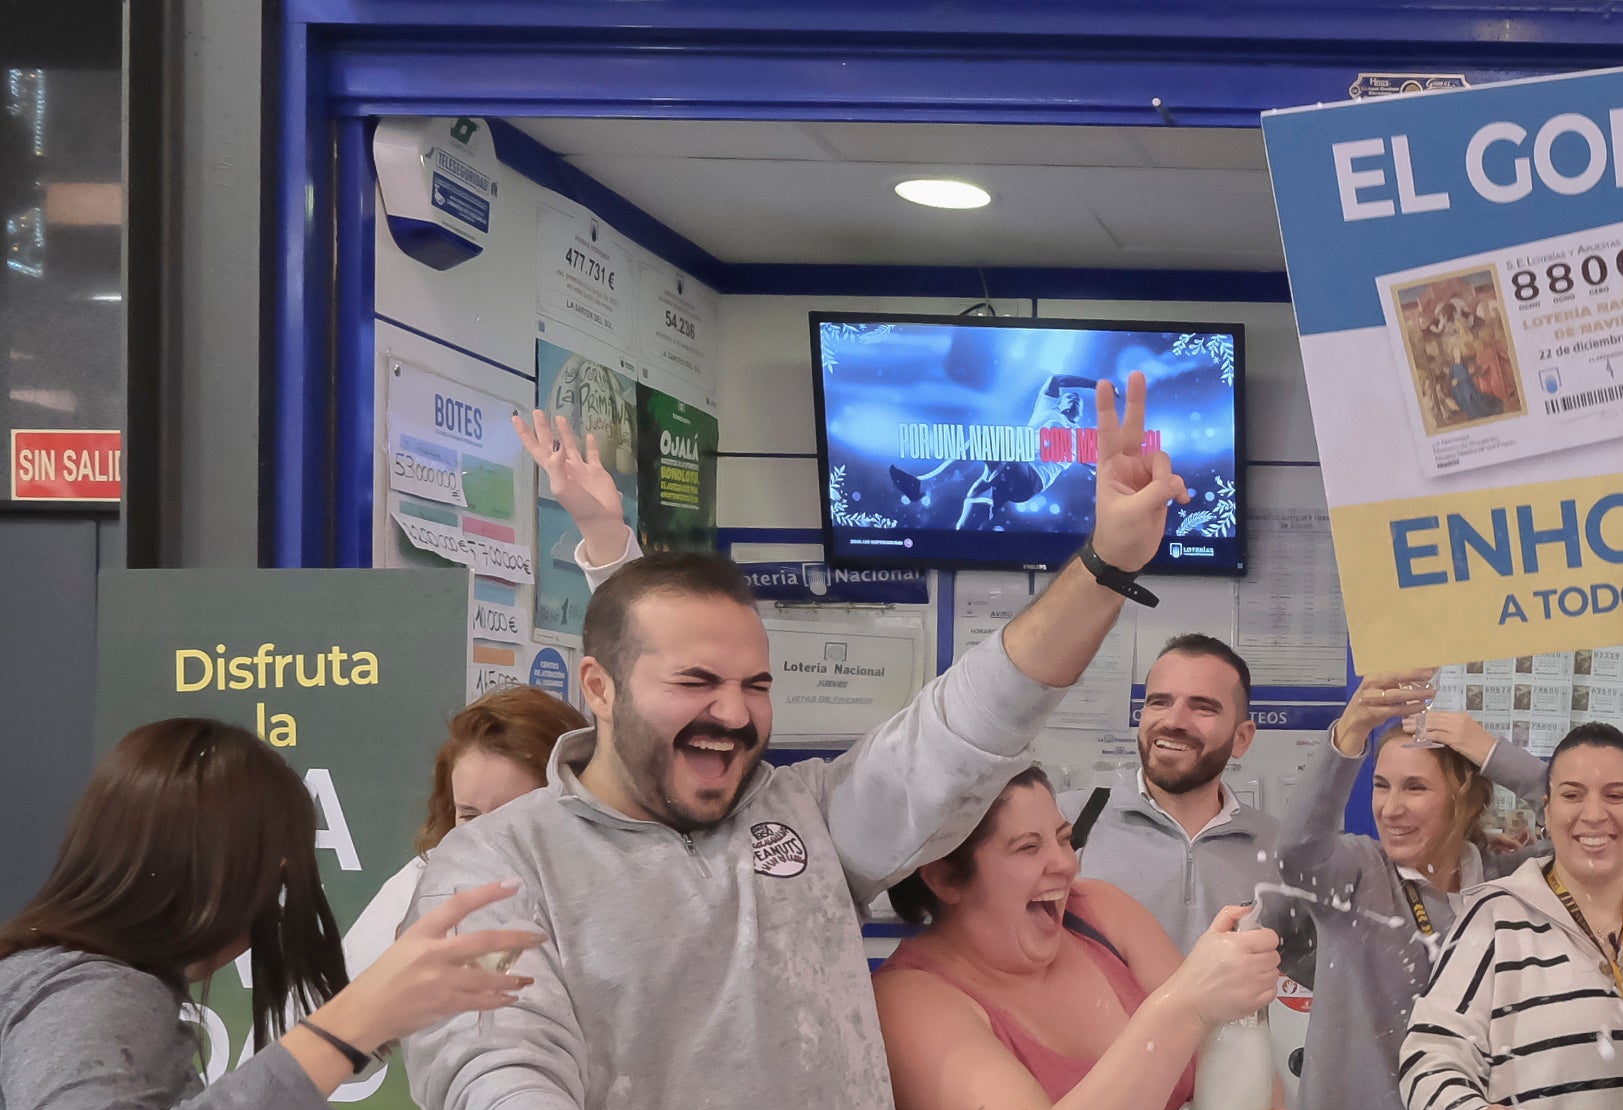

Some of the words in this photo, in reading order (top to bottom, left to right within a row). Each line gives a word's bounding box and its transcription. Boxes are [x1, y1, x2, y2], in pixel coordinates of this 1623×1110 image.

[437, 151, 490, 192] TELESEGURIDAD
[1332, 133, 1450, 221] EL
[565, 247, 605, 285] 477.731
[608, 272, 615, 291] €
[1523, 306, 1592, 330] LOTERÍA
[1554, 328, 1576, 340] DE
[1538, 349, 1553, 361] 22
[1556, 343, 1571, 356] de
[434, 393, 482, 441] BOTES
[660, 430, 699, 461] OJALÁ
[899, 423, 930, 459] POR
[933, 424, 966, 461] UNA
[969, 425, 1035, 463] NAVIDAD
[1040, 427, 1073, 463] CON
[20, 449, 55, 481] SIN
[744, 570, 798, 586] oteria
[835, 568, 920, 583] Nacional
[1498, 594, 1529, 626] A
[175, 643, 379, 692] Disfruta
[834, 663, 885, 677] Nacional
[257, 702, 297, 748] la
[1250, 711, 1287, 724] TEOS
[754, 838, 803, 862] EANUTS
